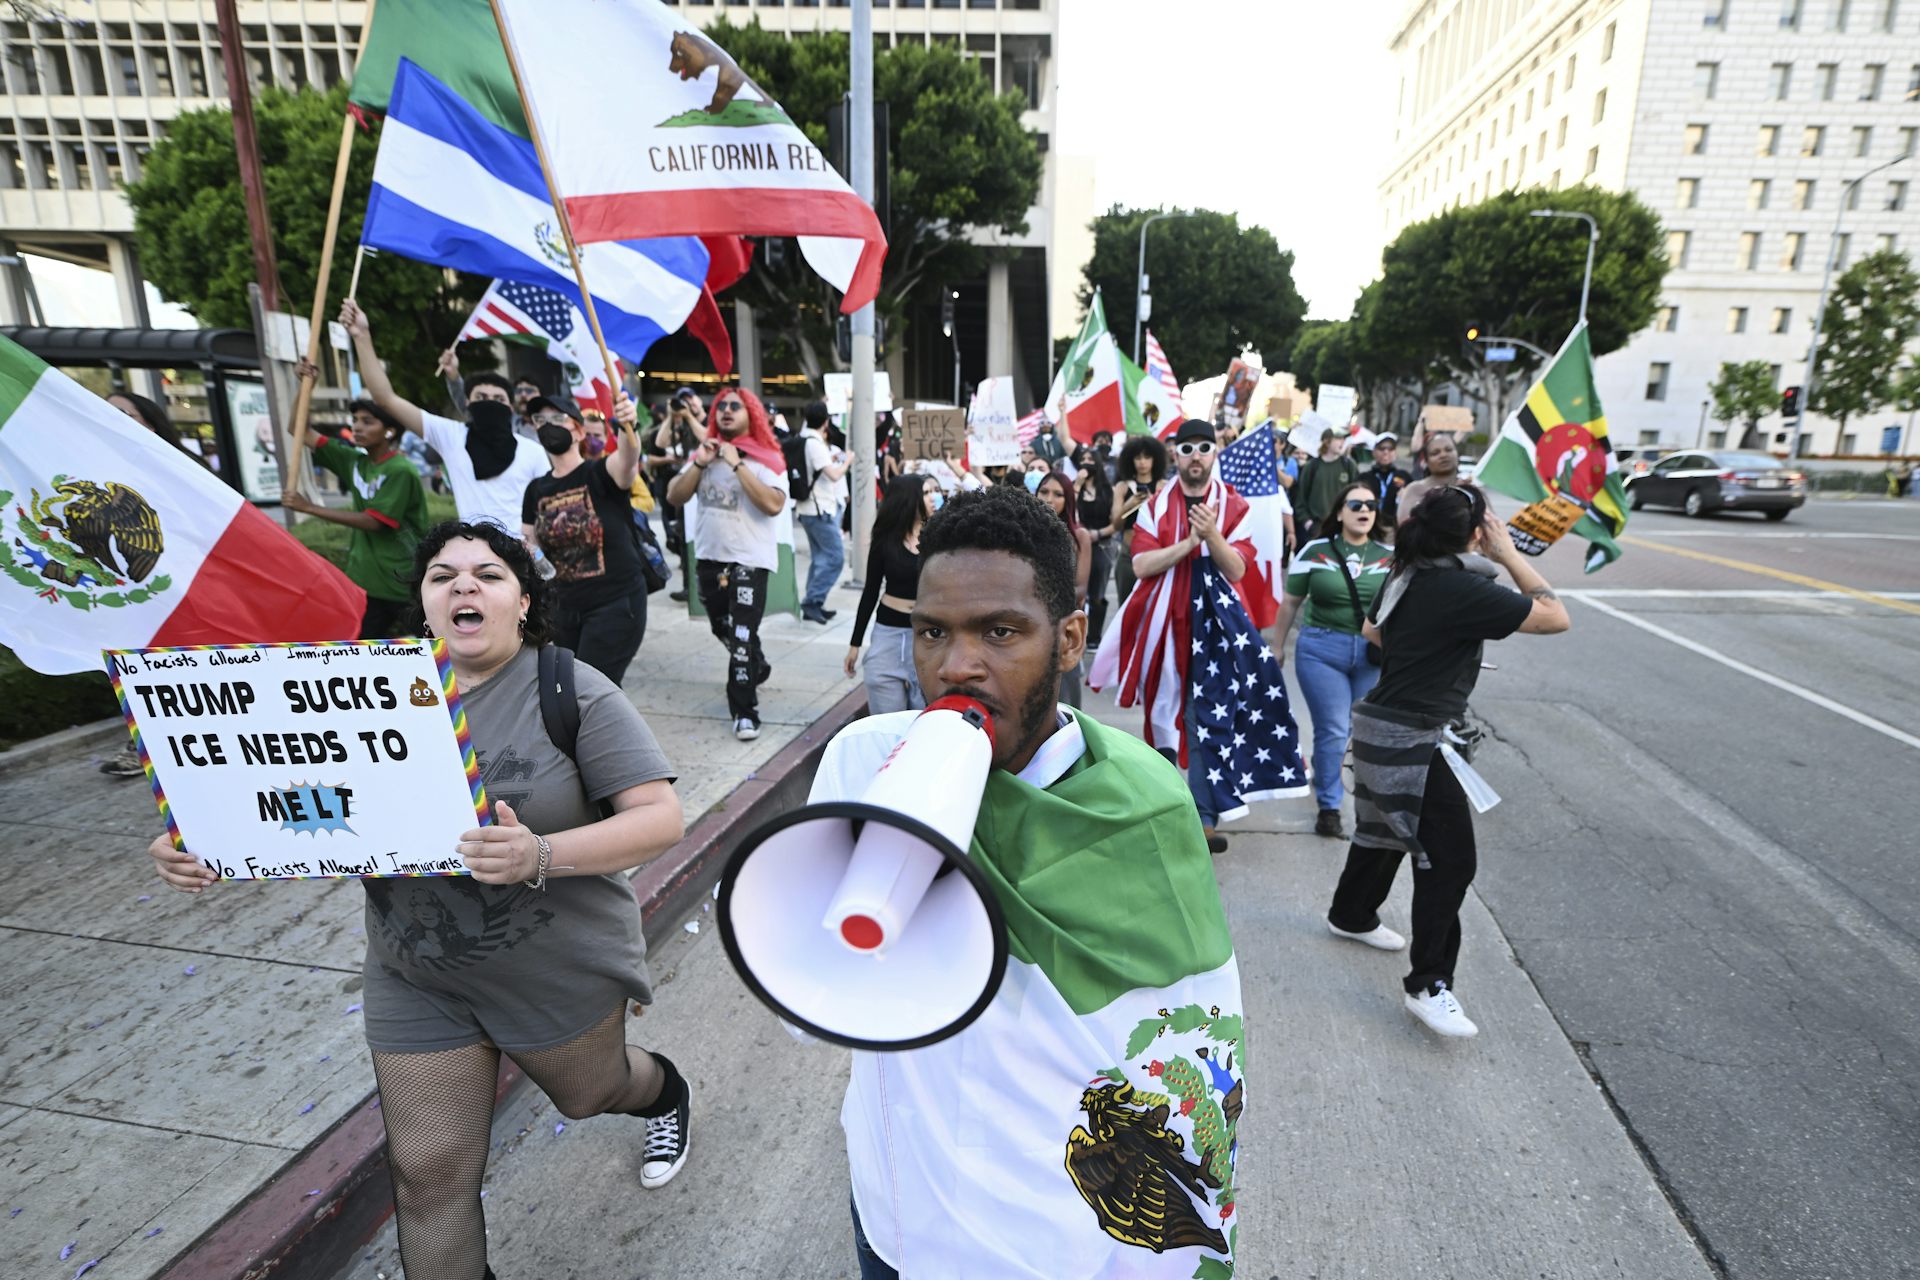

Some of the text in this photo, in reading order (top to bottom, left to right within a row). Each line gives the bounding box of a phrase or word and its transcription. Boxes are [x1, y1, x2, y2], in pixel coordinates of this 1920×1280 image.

[648, 143, 779, 172] CALIFORNIA
[907, 414, 956, 439] FUCK
[915, 438, 957, 461] ICE
[112, 654, 138, 677] No
[139, 653, 198, 671] Facists
[287, 645, 360, 664] Immigrants
[368, 644, 427, 657] Welcome
[134, 676, 397, 717] TRUMP SUCKS
[167, 729, 409, 767] ICE NEEDS TO
[257, 787, 353, 822] MELT
[204, 851, 463, 879] No Facists Allowed! Immigrants
